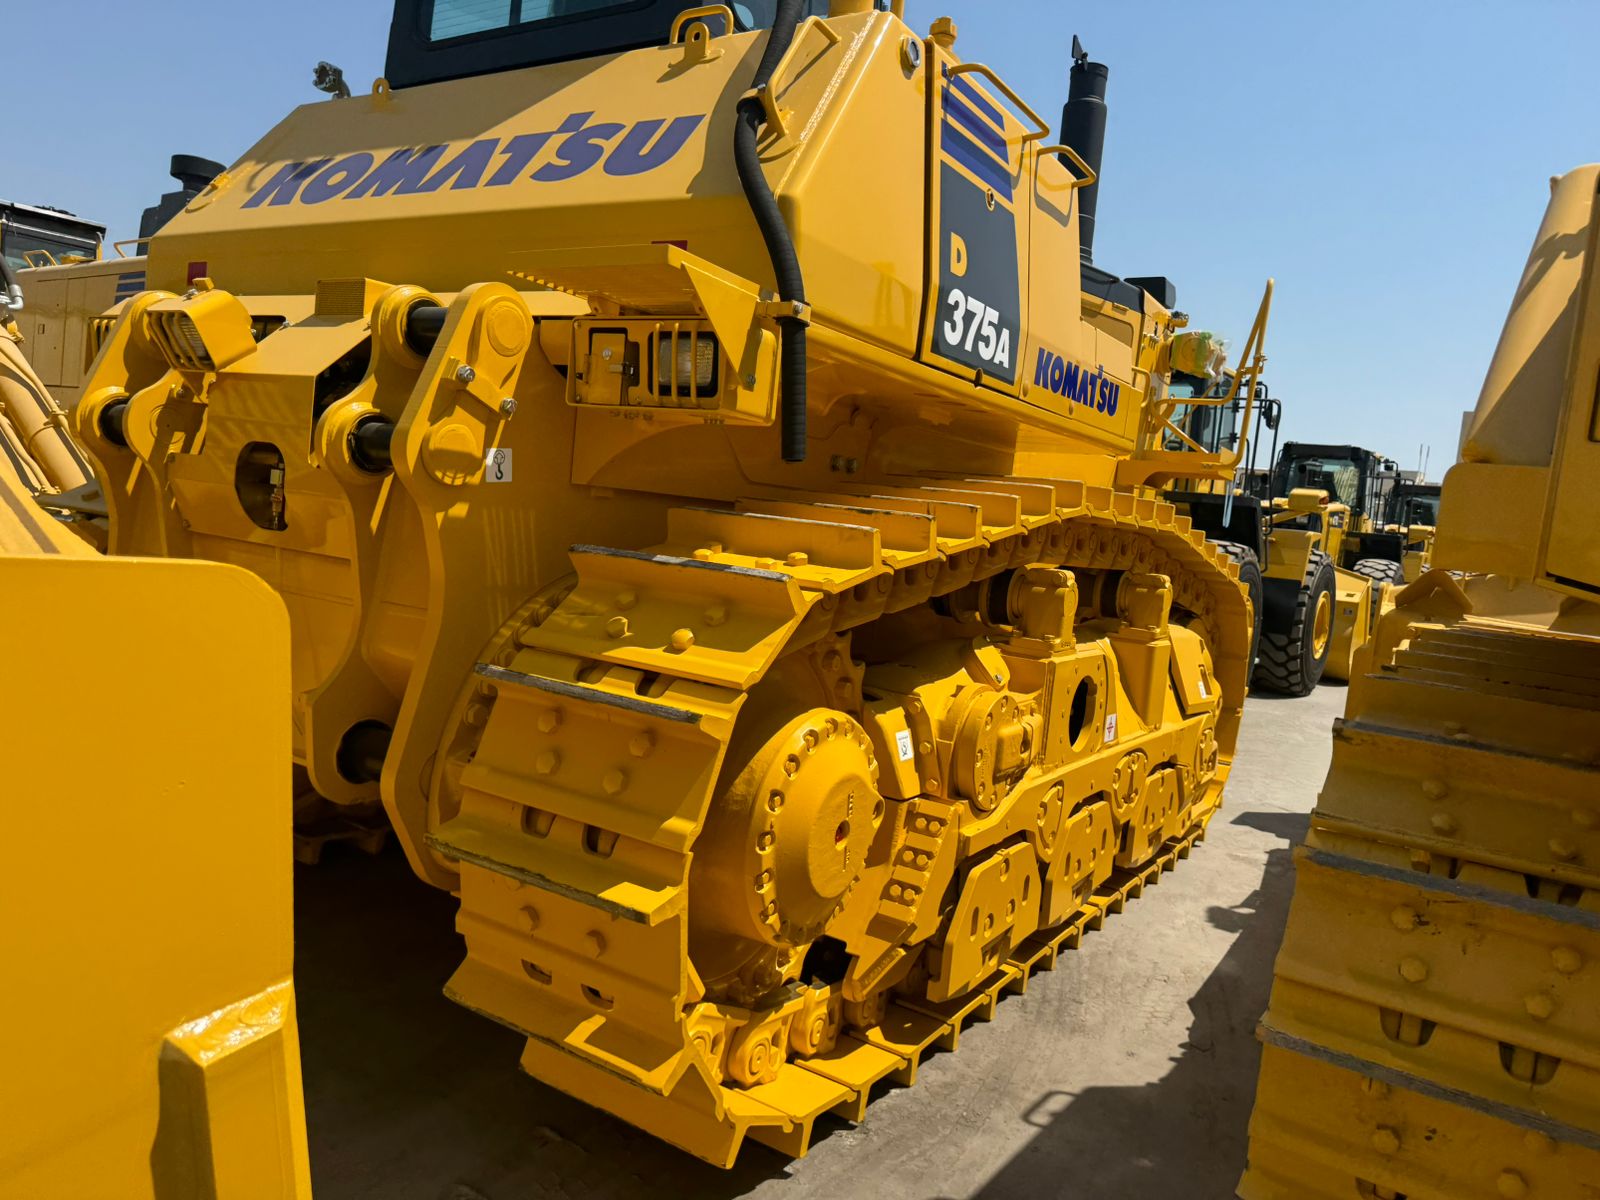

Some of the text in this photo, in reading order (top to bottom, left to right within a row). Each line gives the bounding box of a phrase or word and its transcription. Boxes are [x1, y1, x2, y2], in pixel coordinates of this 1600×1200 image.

[240, 110, 707, 210] KOMATSU
[950, 231, 968, 277] D
[943, 288, 1011, 369] 375A
[1033, 347, 1121, 417] KOMATSU
